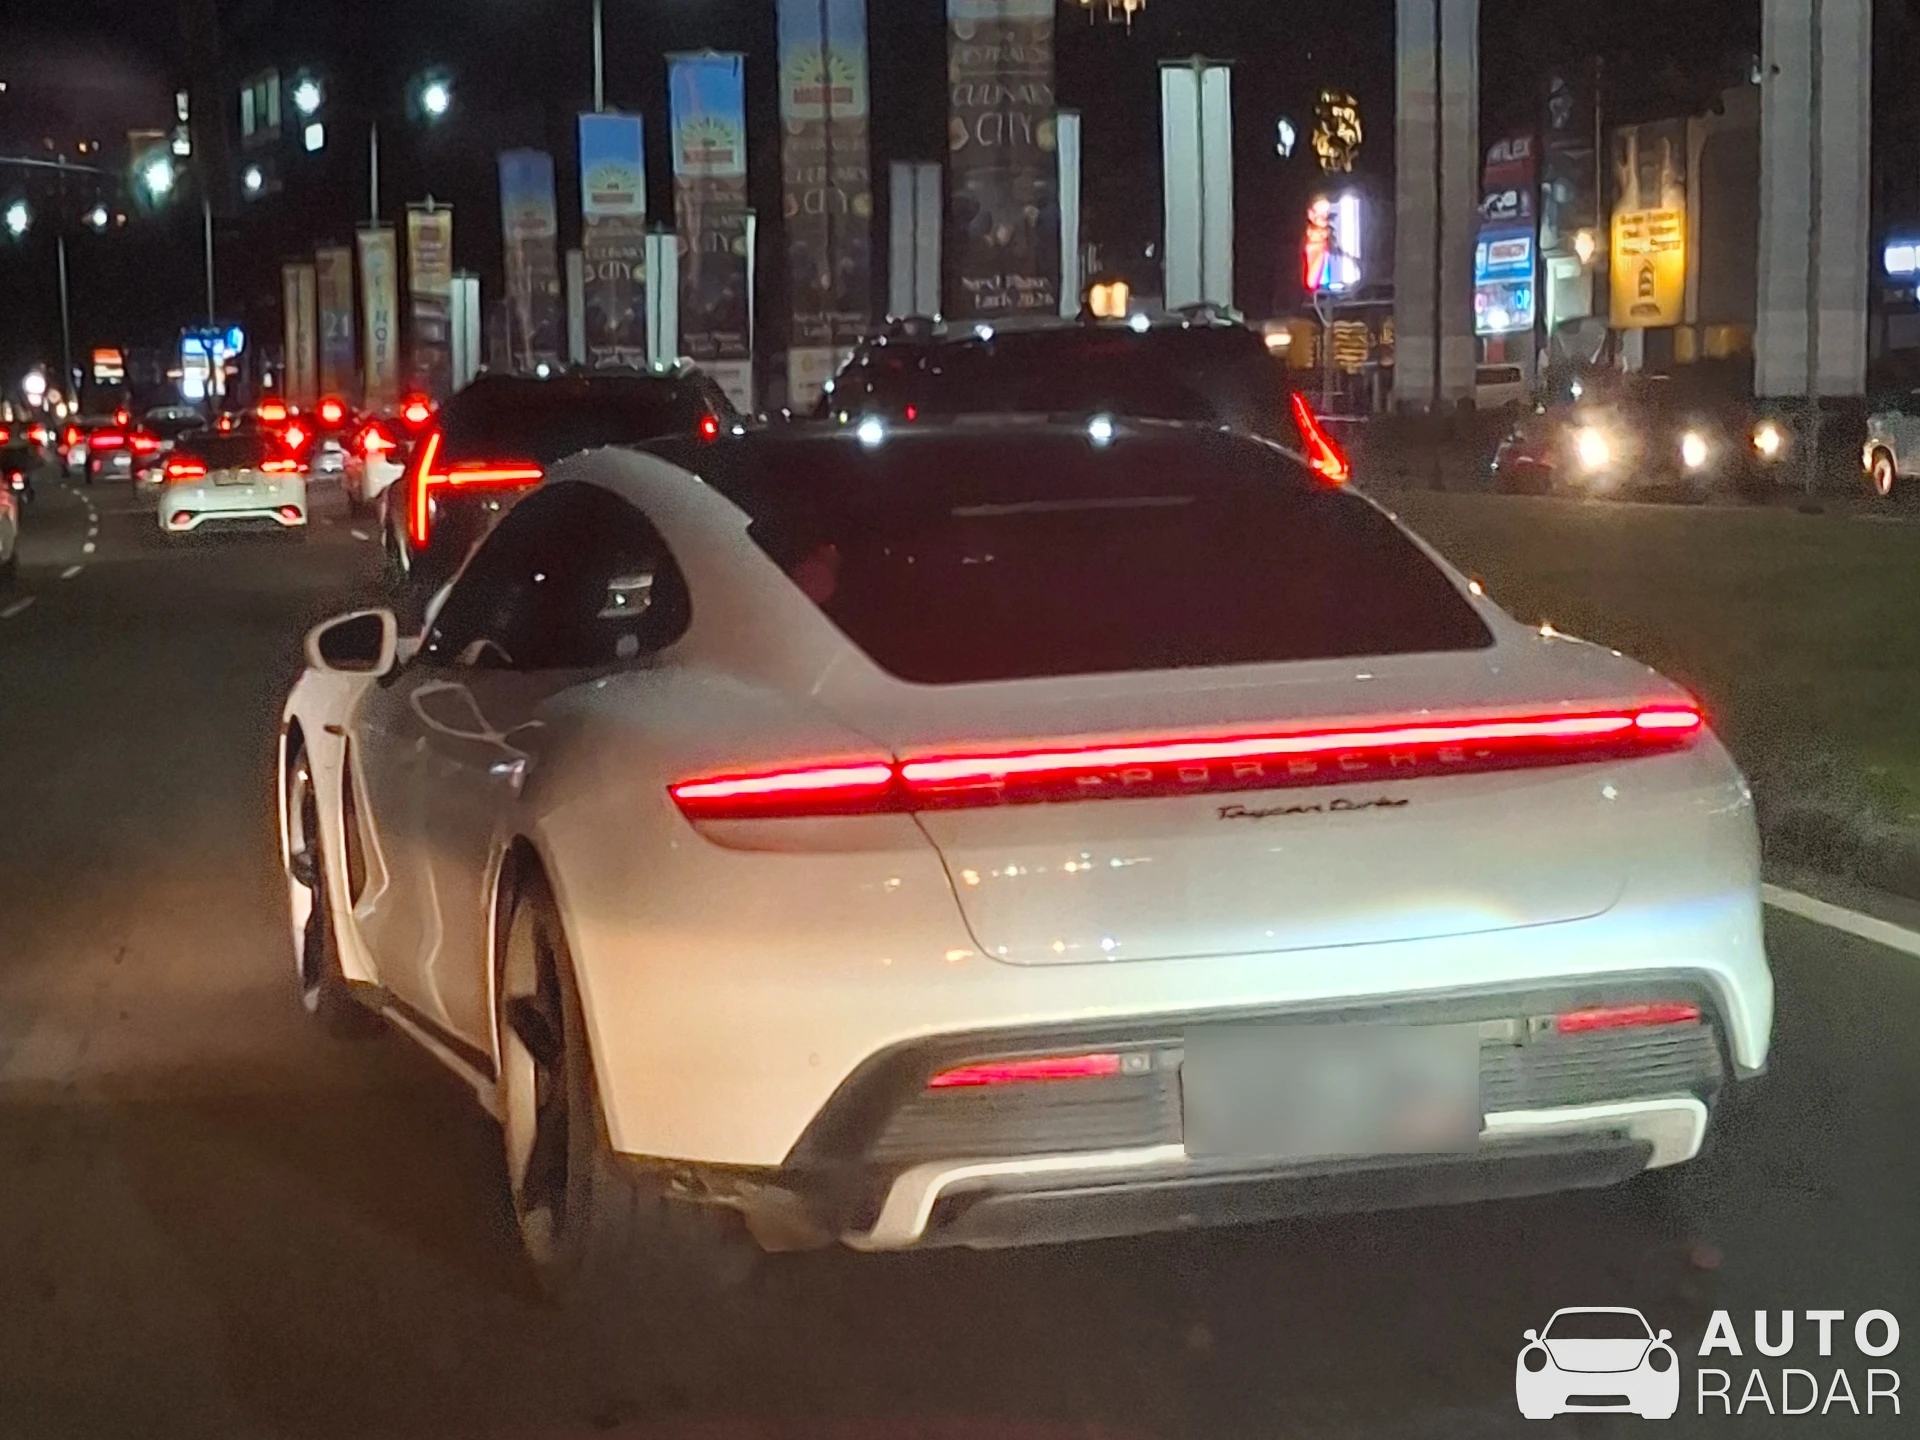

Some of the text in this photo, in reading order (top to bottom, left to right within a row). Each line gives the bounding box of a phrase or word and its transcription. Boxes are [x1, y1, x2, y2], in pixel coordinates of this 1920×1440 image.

[977, 112, 1031, 146] CITY
[1121, 746, 1467, 785] PORSCHE
[1217, 804, 1321, 819] Taycan
